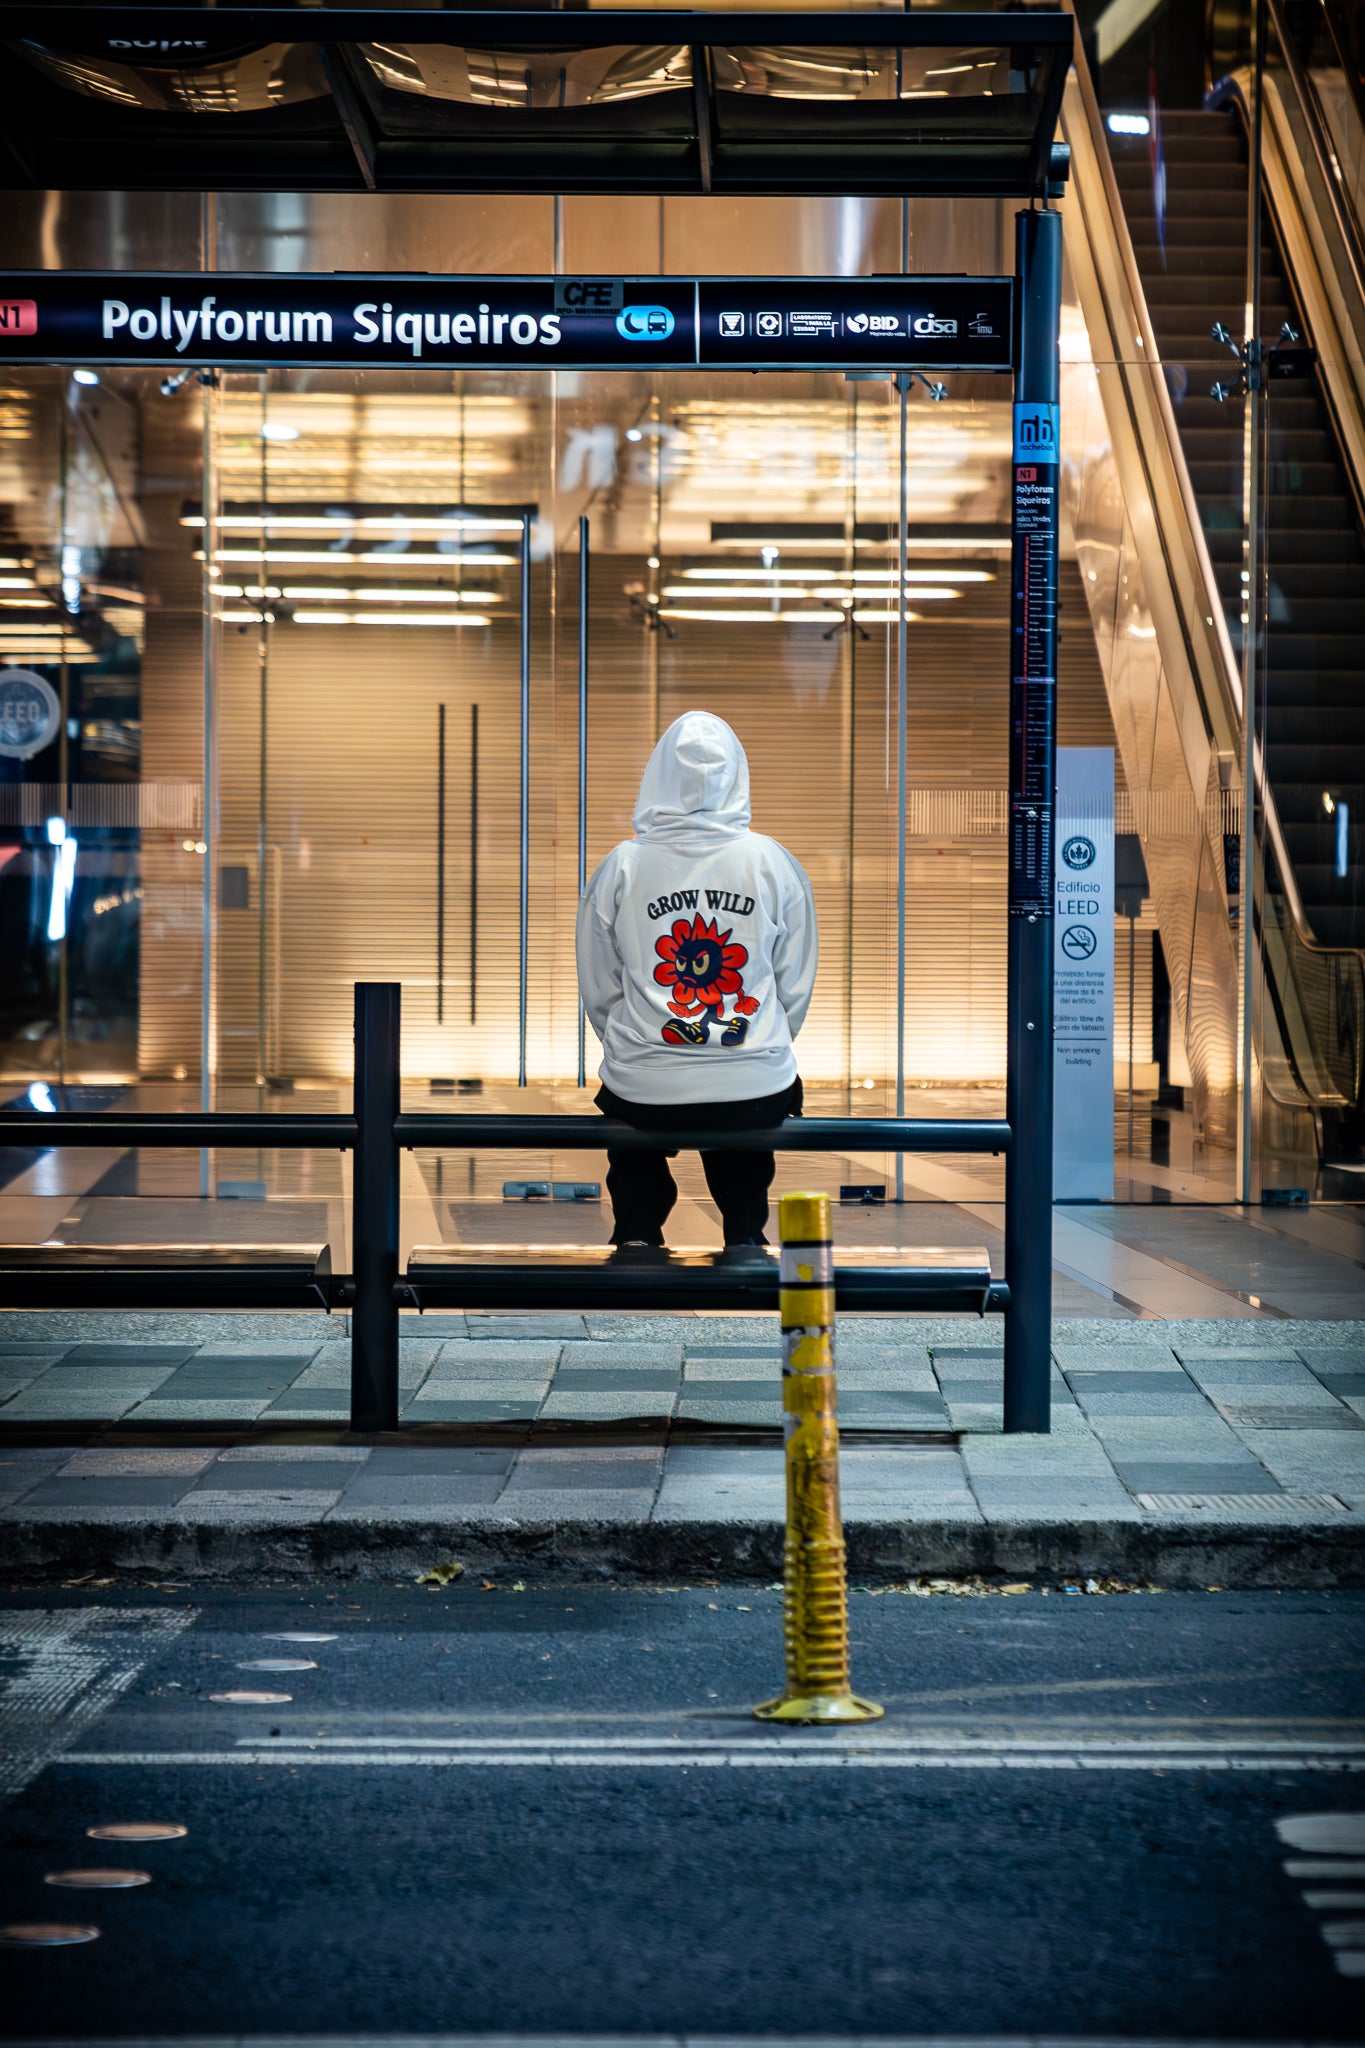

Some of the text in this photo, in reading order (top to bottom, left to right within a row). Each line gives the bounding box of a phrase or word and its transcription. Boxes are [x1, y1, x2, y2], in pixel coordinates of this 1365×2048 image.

[563, 281, 614, 306] CFE
[102, 297, 333, 353] Polyforum
[352, 303, 562, 357] Siqueiros
[868, 315, 899, 331] BID
[913, 312, 958, 334] cisa
[1016, 484, 1054, 496] Polyforum
[1016, 496, 1051, 506] Siqueiros
[0, 701, 40, 722] EED
[1057, 881, 1101, 893] Edificio
[647, 889, 756, 920] GROW WILD
[1058, 900, 1100, 915] LEED
[1065, 1058, 1092, 1067] building
